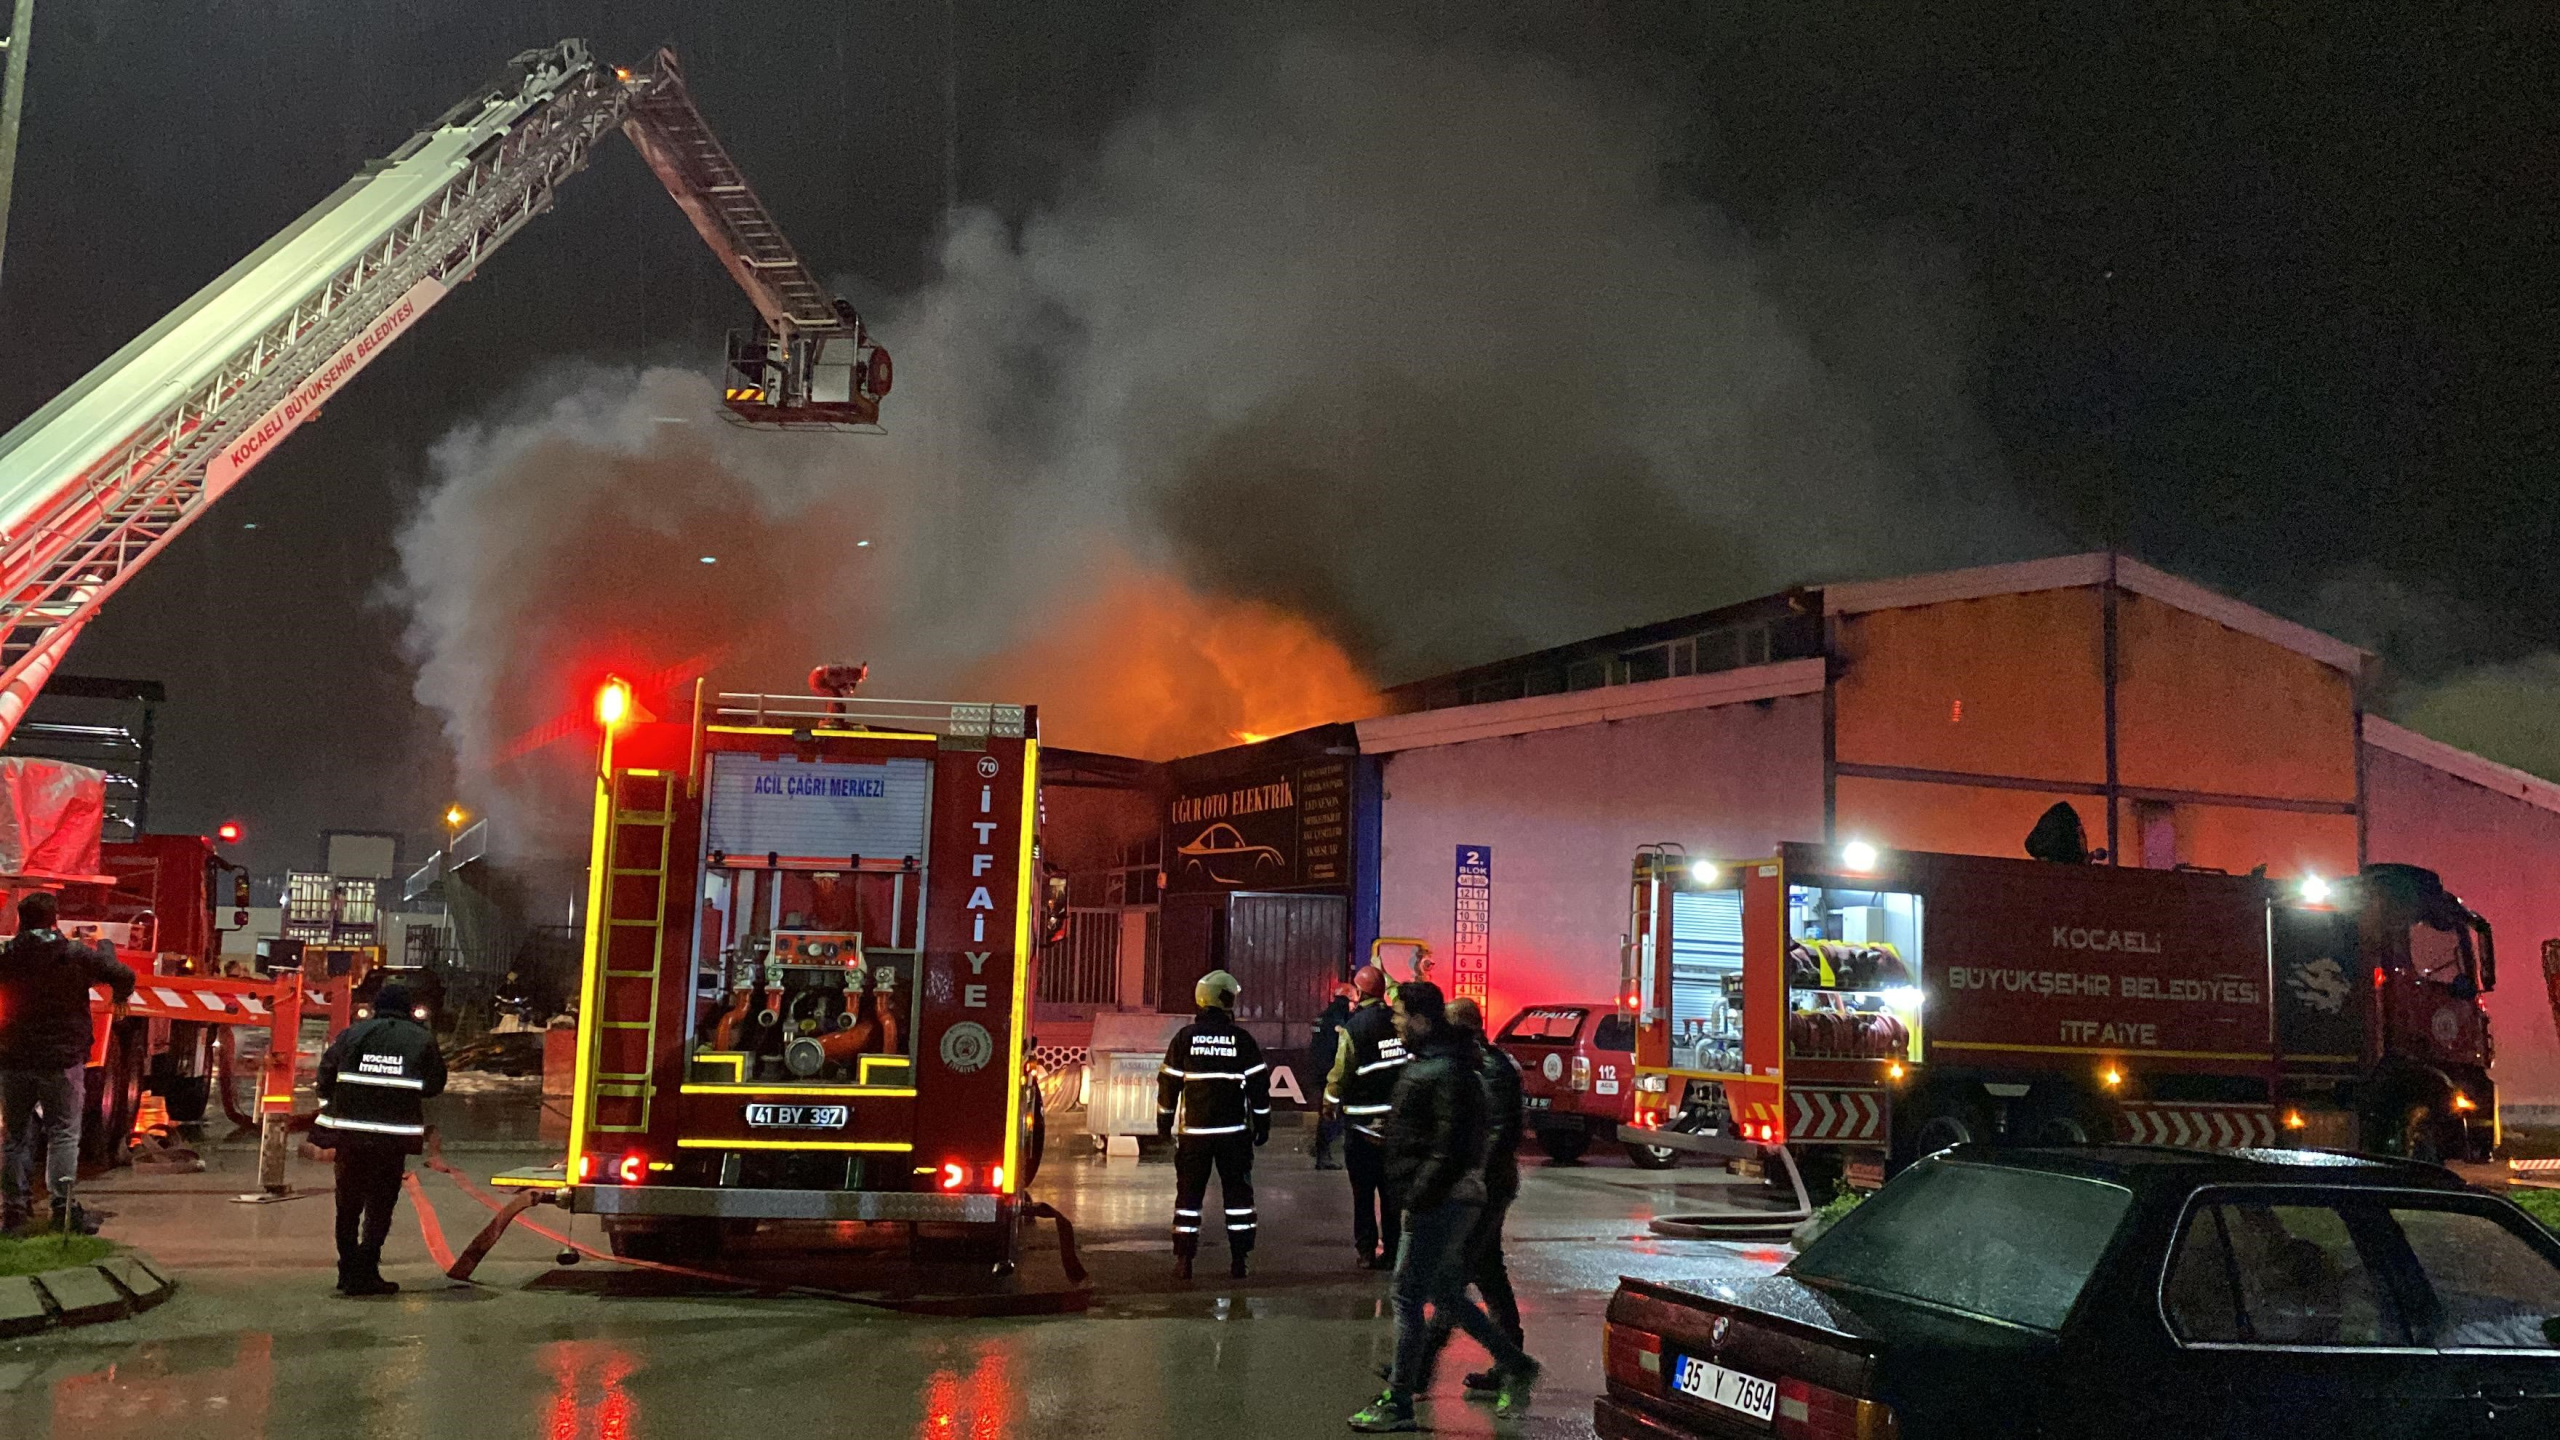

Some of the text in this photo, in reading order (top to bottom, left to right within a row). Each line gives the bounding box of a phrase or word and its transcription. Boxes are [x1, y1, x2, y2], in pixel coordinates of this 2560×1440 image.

[231, 297, 414, 467] KOCAELİ BÜYÜKŞEHİR BELEDİYESİ
[981, 762, 995, 773] 70
[754, 772, 884, 800] ACİL ÇAĞRI MERKEZİ
[1203, 793, 1227, 819] OTO
[1232, 775, 1293, 815] ELEKTRİK
[1466, 851, 1484, 865] 2.
[1459, 866, 1487, 875] BLOK
[1460, 889, 1485, 899] 12 17
[1459, 901, 1485, 910] 11 11
[1459, 912, 1485, 921] 10 10
[1462, 922, 1485, 932] 9 19
[2052, 926, 2161, 953] KOCAELİ
[1460, 958, 1482, 968] 6 6
[1461, 974, 1484, 982] 5 15
[1460, 985, 1483, 994] 4 14
[1949, 966, 2259, 1003] BÜYÜKŞEHİR BELEDİYESİ
[2060, 1020, 2157, 1045] İTFAİYE
[1192, 1035, 1235, 1045] KOCAELİ
[1378, 1038, 1402, 1050] KOCAE
[1190, 1045, 1237, 1057] İTFAİYESİ
[362, 1054, 403, 1065] KOCAELİ
[359, 1062, 403, 1075] İTFAİYESİ
[1598, 1064, 1616, 1079] 112
[755, 1107, 840, 1124] 41 BY 397
[1683, 1361, 1774, 1416] 35 Y 7694
